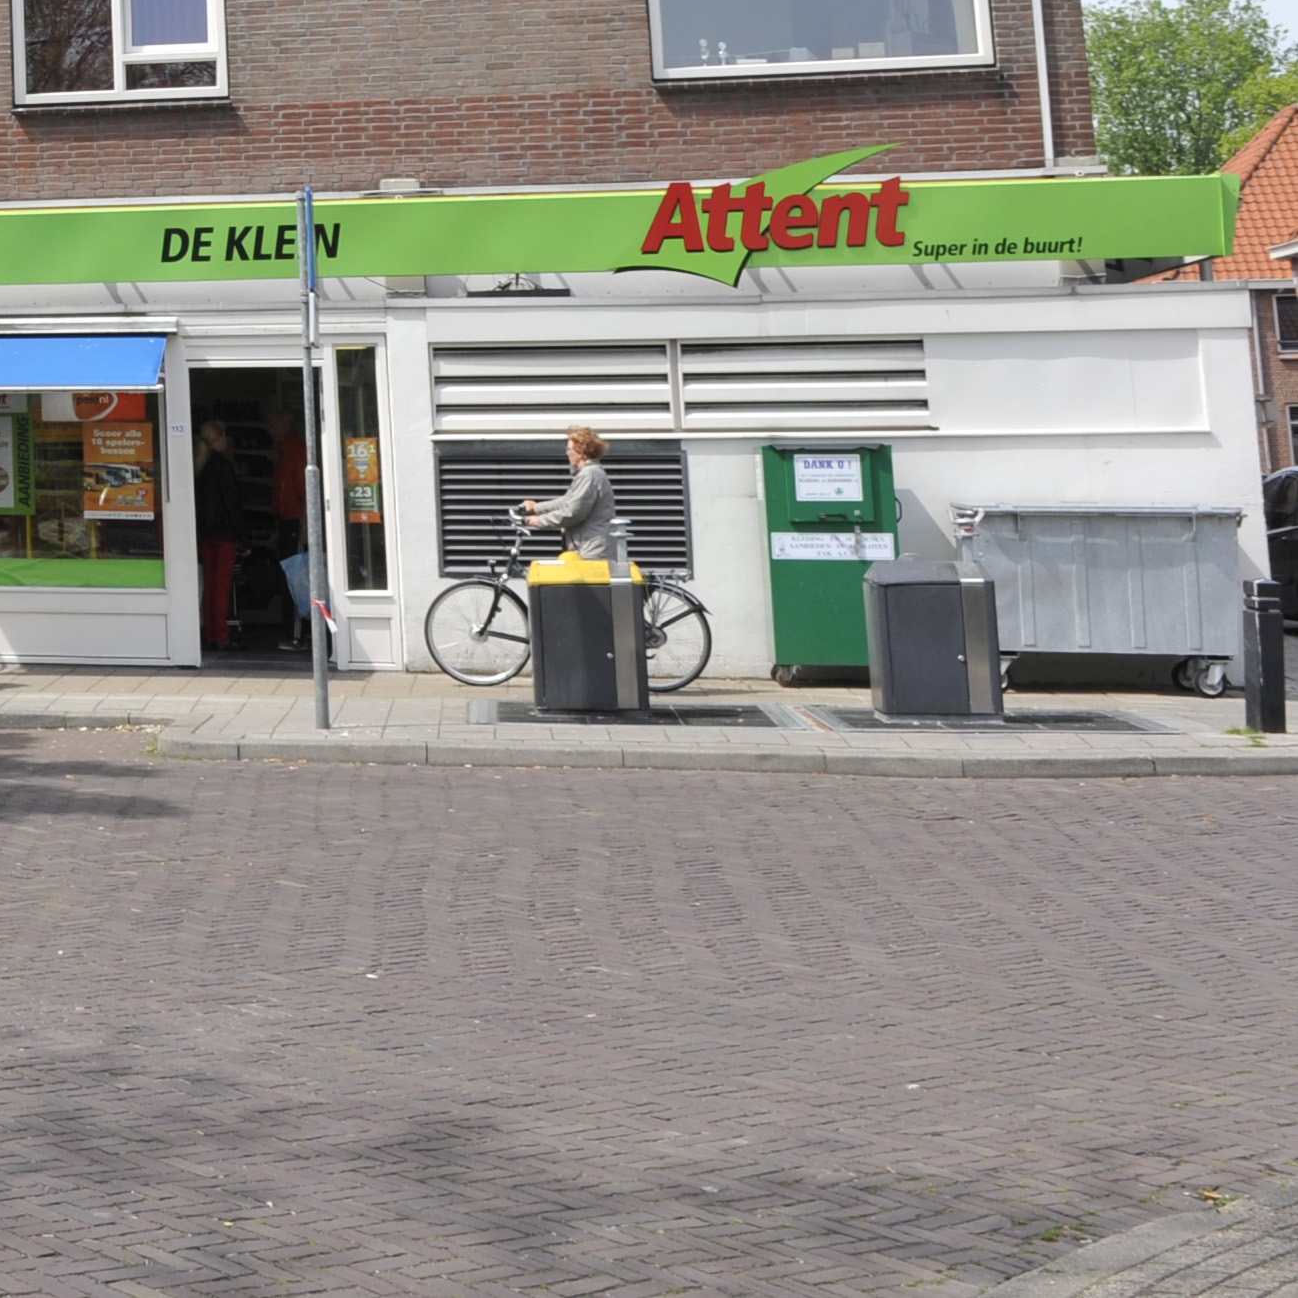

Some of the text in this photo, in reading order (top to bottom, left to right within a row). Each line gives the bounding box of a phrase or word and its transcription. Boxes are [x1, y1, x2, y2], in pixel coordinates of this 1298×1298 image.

[640, 176, 910, 254] Attent
[161, 223, 341, 263] DE KLEN
[912, 236, 1083, 261] Super in de buurt!
[93, 429, 142, 438] Scoor alle
[17, 416, 31, 508] AANBIEDING
[803, 459, 834, 470] DANK
[837, 459, 845, 470] U
